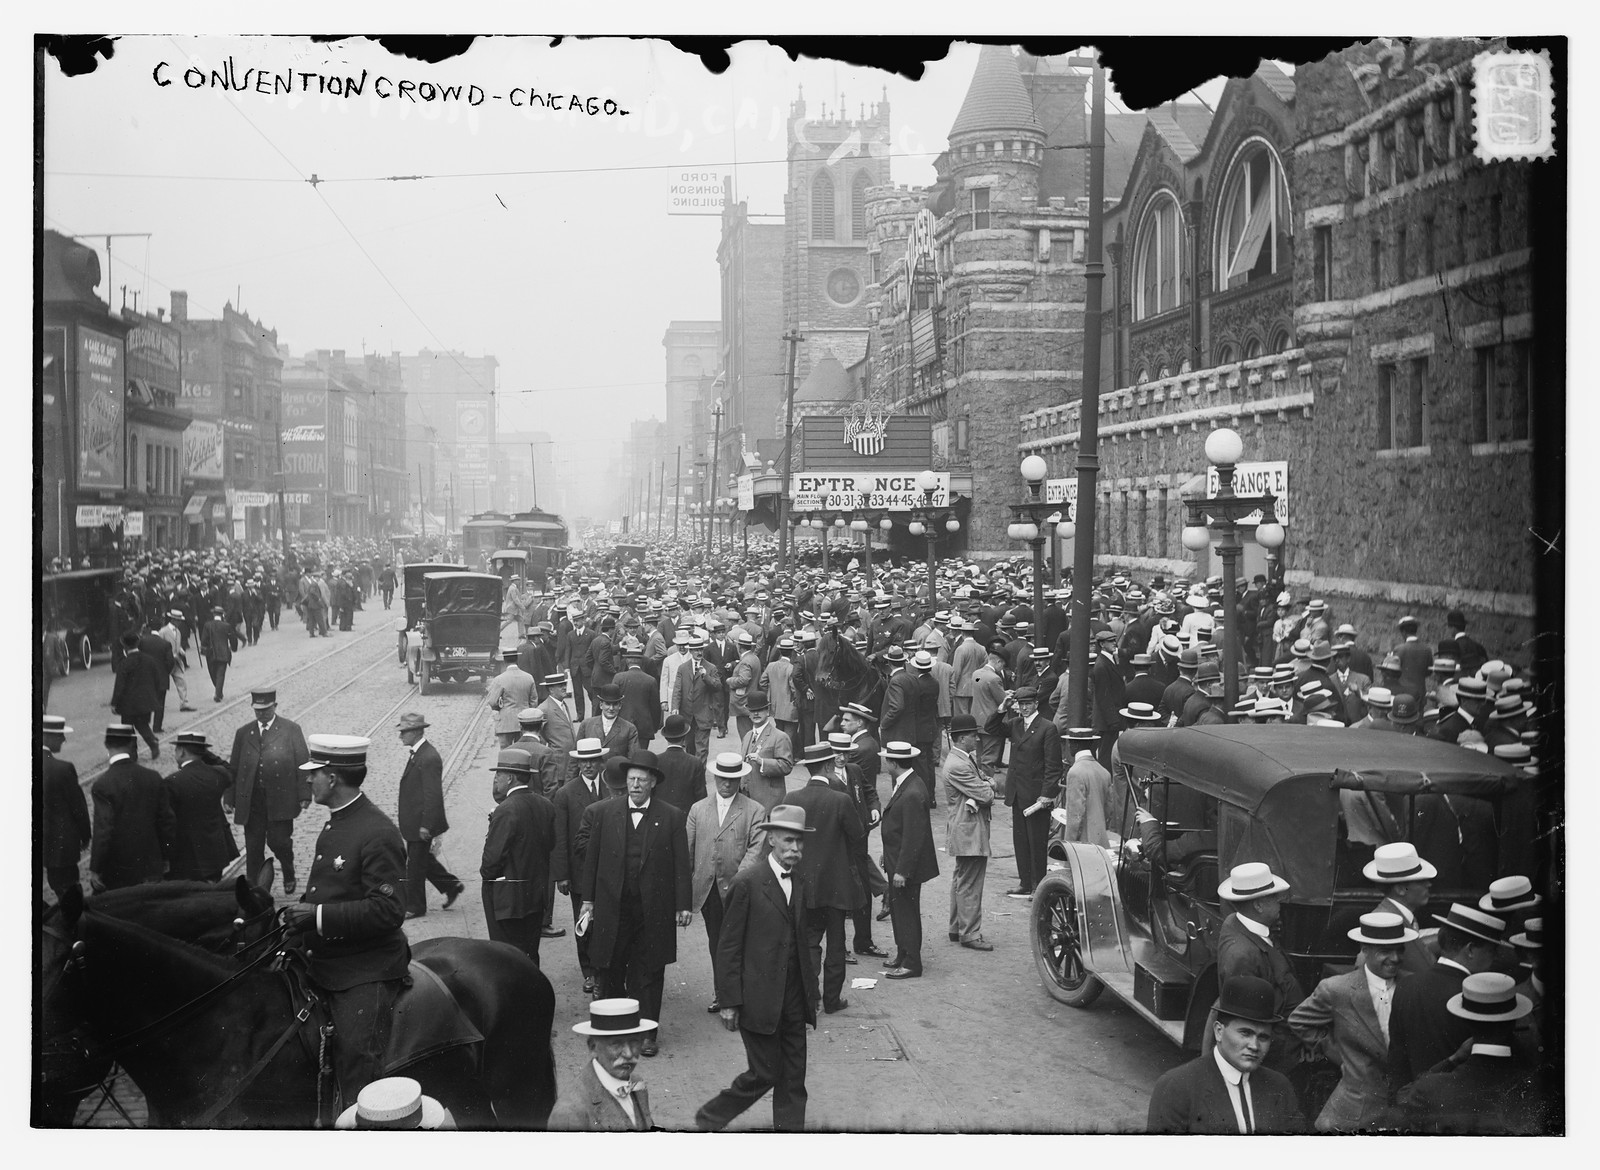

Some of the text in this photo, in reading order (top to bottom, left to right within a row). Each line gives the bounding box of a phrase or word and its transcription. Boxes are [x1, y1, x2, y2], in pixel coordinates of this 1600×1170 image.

[284, 453, 325, 474] STORIA
[799, 477, 916, 492] ENTRNCE
[1210, 471, 1270, 494] ERANCE
